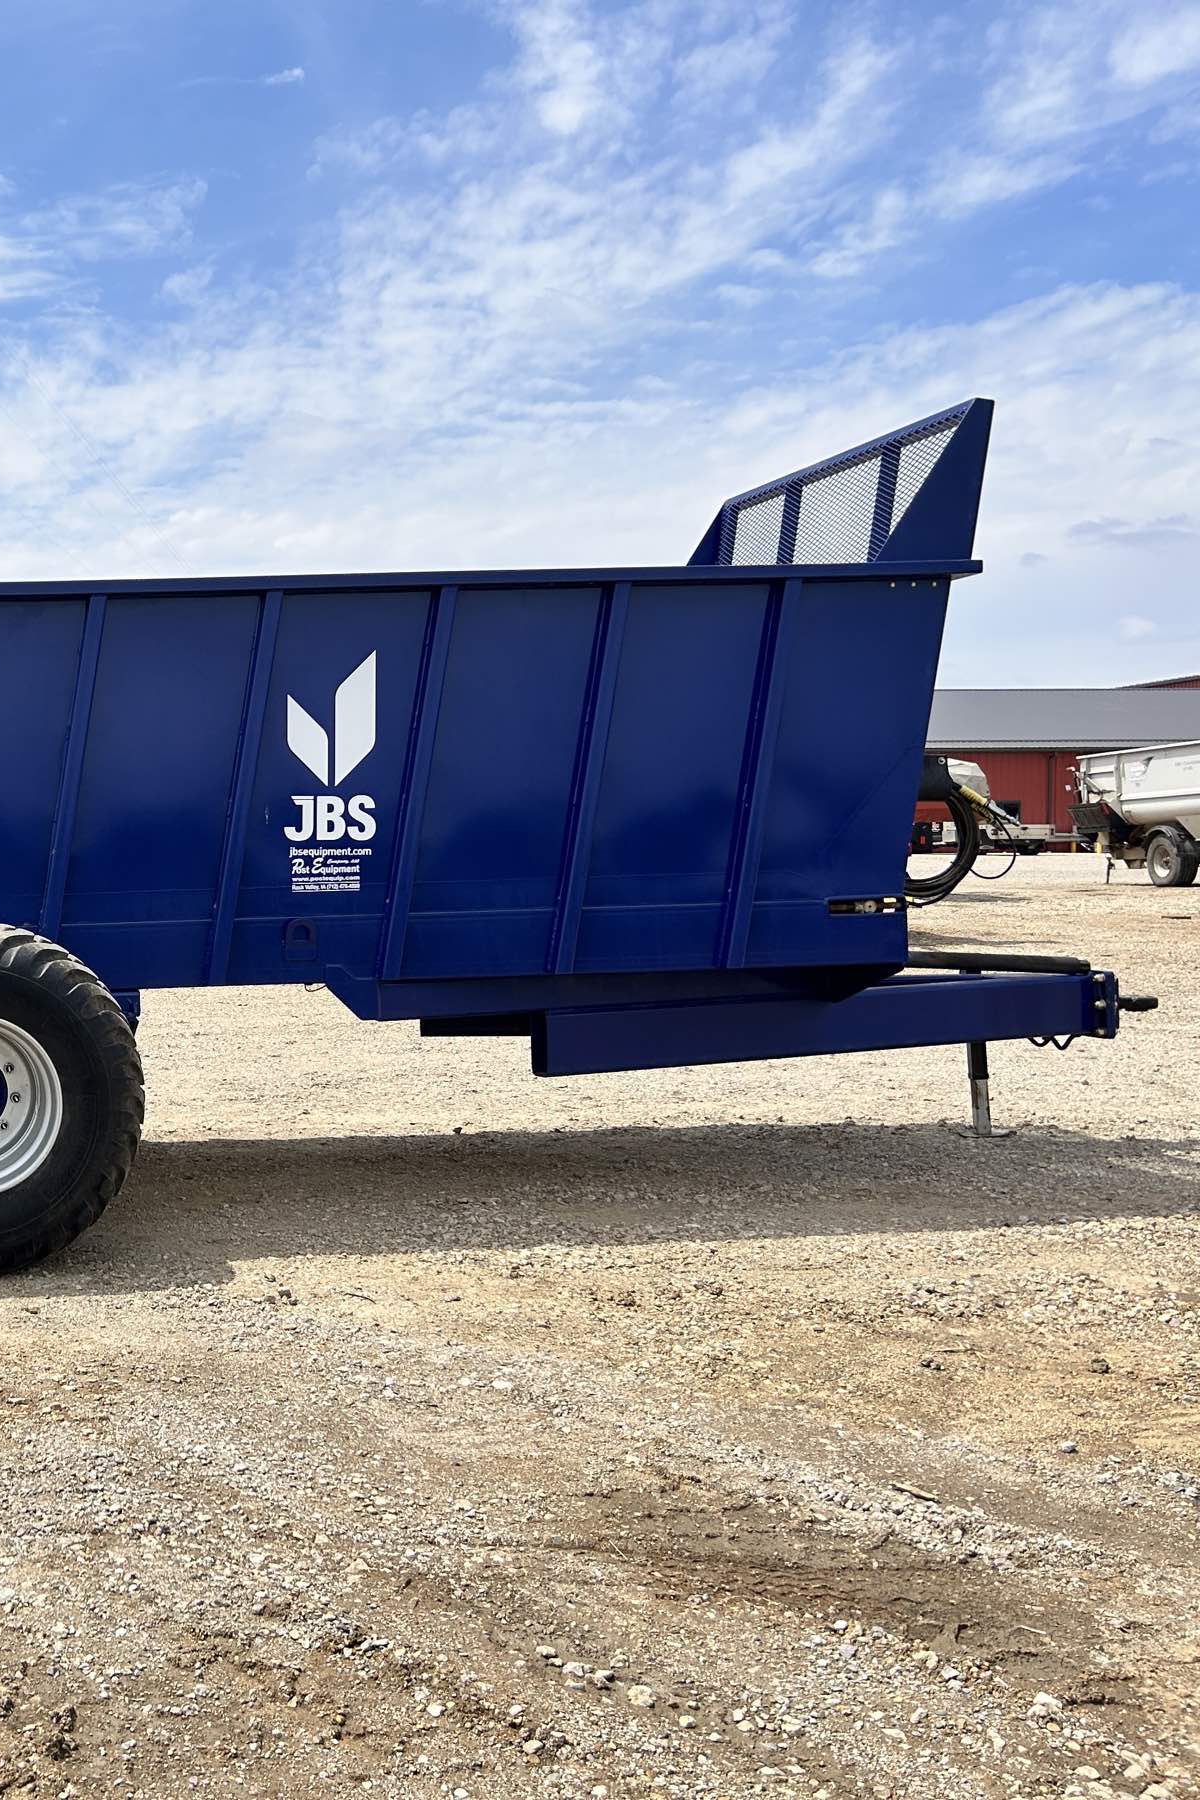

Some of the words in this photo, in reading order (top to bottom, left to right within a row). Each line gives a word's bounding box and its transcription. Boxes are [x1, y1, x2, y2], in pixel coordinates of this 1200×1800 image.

[284, 795, 377, 841] JBS
[289, 847, 372, 858] jbsequipment.com
[292, 858, 310, 874] Post
[311, 858, 360, 875] Equipment
